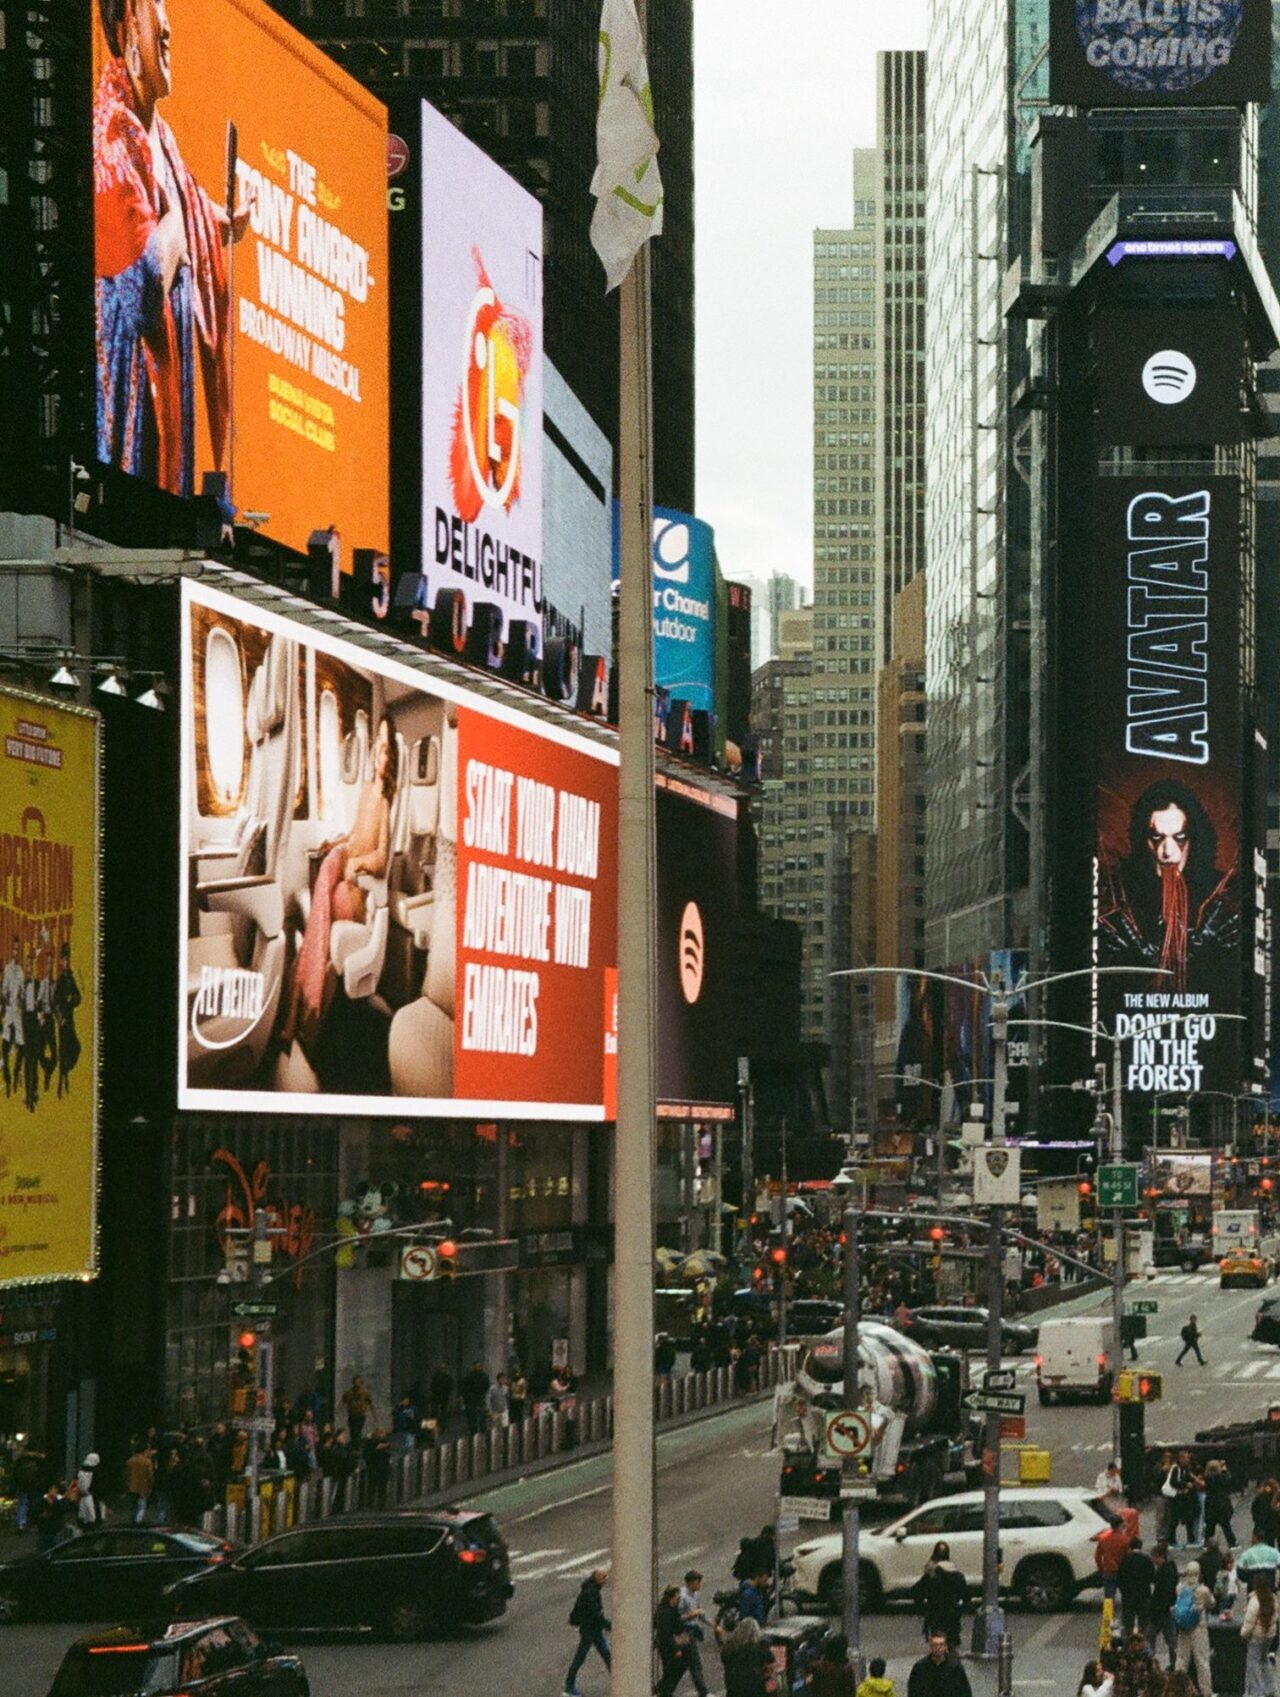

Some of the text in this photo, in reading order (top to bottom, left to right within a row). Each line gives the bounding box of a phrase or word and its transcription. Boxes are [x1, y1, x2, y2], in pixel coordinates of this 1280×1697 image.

[1086, 37, 1232, 68] COMING
[286, 149, 317, 206] THE
[235, 156, 294, 253] TONY
[256, 239, 346, 353] WINNING
[239, 296, 363, 404] BROADWAY MUSICAL
[662, 587, 710, 622] Channel
[653, 615, 697, 643] utdoor
[1126, 489, 1211, 766] AVATAR
[463, 758, 515, 857] START
[516, 775, 556, 869] YOUR
[556, 789, 601, 880] DUBAI
[462, 860, 593, 970] ADVENTURE WITH
[199, 965, 265, 1020] FLY BETTER
[461, 961, 540, 1057] EMIRATES
[1124, 993, 1210, 1008] THE NEW ALBUM
[1115, 1013, 1217, 1041] DON'T GO
[1133, 1040, 1199, 1066] IN THE
[1127, 1065, 1204, 1092] FOREST
[14, 1326, 38, 1345] SONY
[997, 1398, 1017, 1409] WAY
